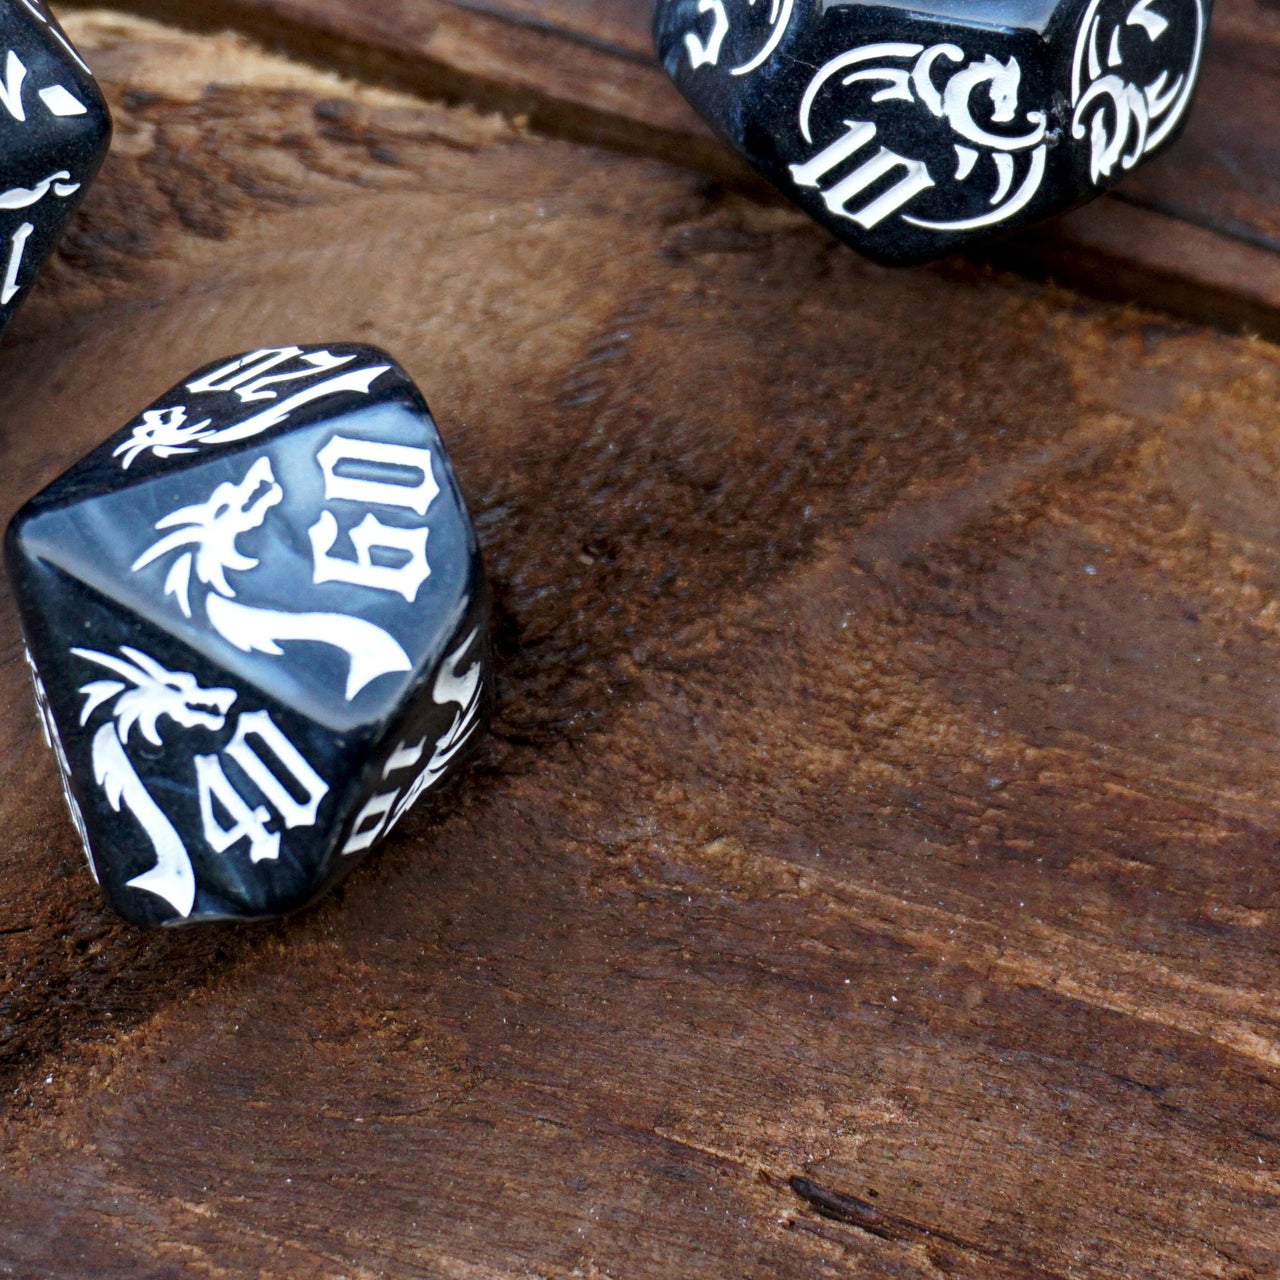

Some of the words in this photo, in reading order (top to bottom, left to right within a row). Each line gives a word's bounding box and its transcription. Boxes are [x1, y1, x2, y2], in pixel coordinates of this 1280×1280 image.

[788, 119, 936, 230] 10
[311, 434, 441, 603] 60
[193, 710, 329, 864] 40
[342, 736, 426, 855] 10
